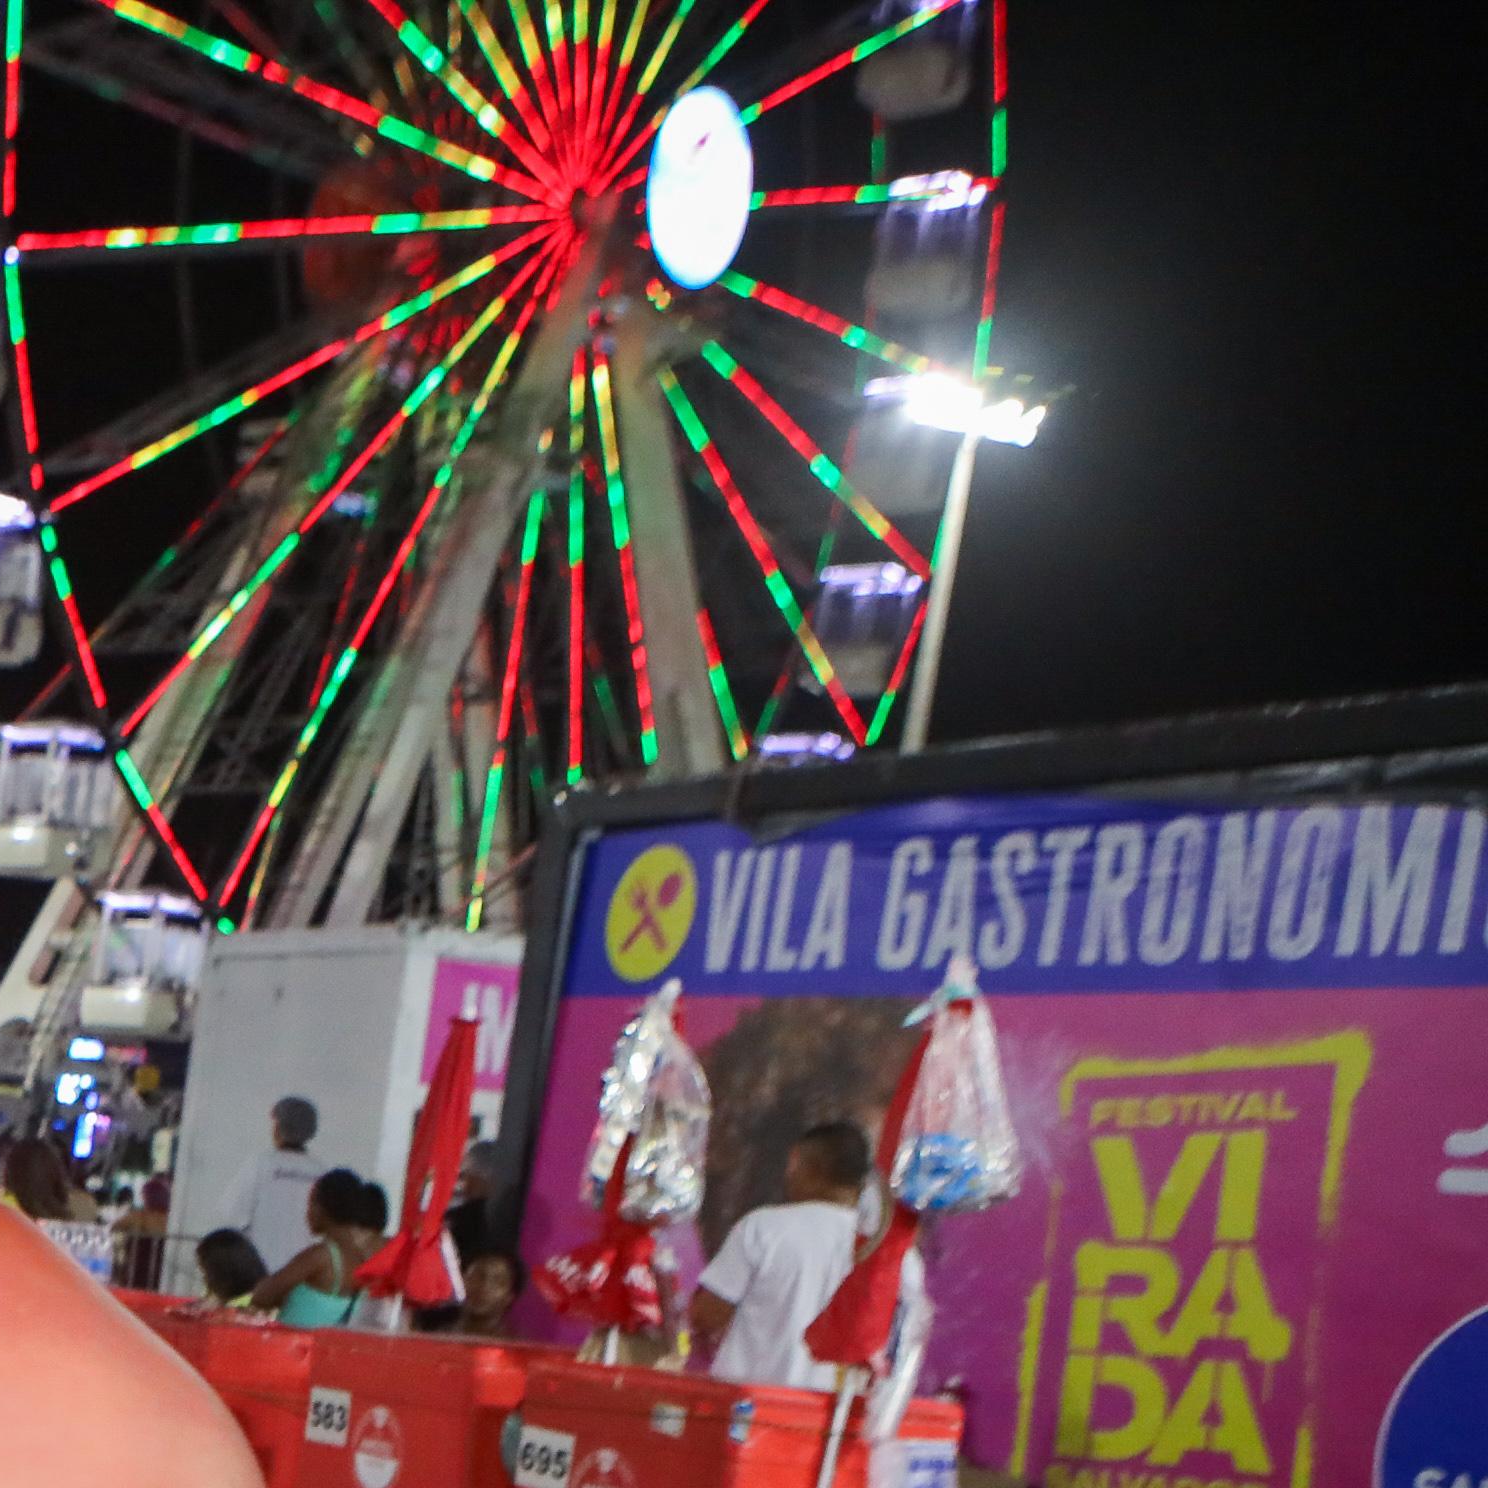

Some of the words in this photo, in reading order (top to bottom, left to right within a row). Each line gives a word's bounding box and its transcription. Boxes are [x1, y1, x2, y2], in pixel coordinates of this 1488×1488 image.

[704, 842, 853, 974] VILA
[876, 802, 1488, 972] GASTRONOMI
[1089, 1090, 1300, 1129] FESTIVAL
[1090, 1128, 1267, 1241] VI
[1068, 1238, 1291, 1361] RA
[310, 1400, 348, 1433] 583
[520, 1441, 568, 1480] 695
[1056, 1354, 1272, 1475] DA
